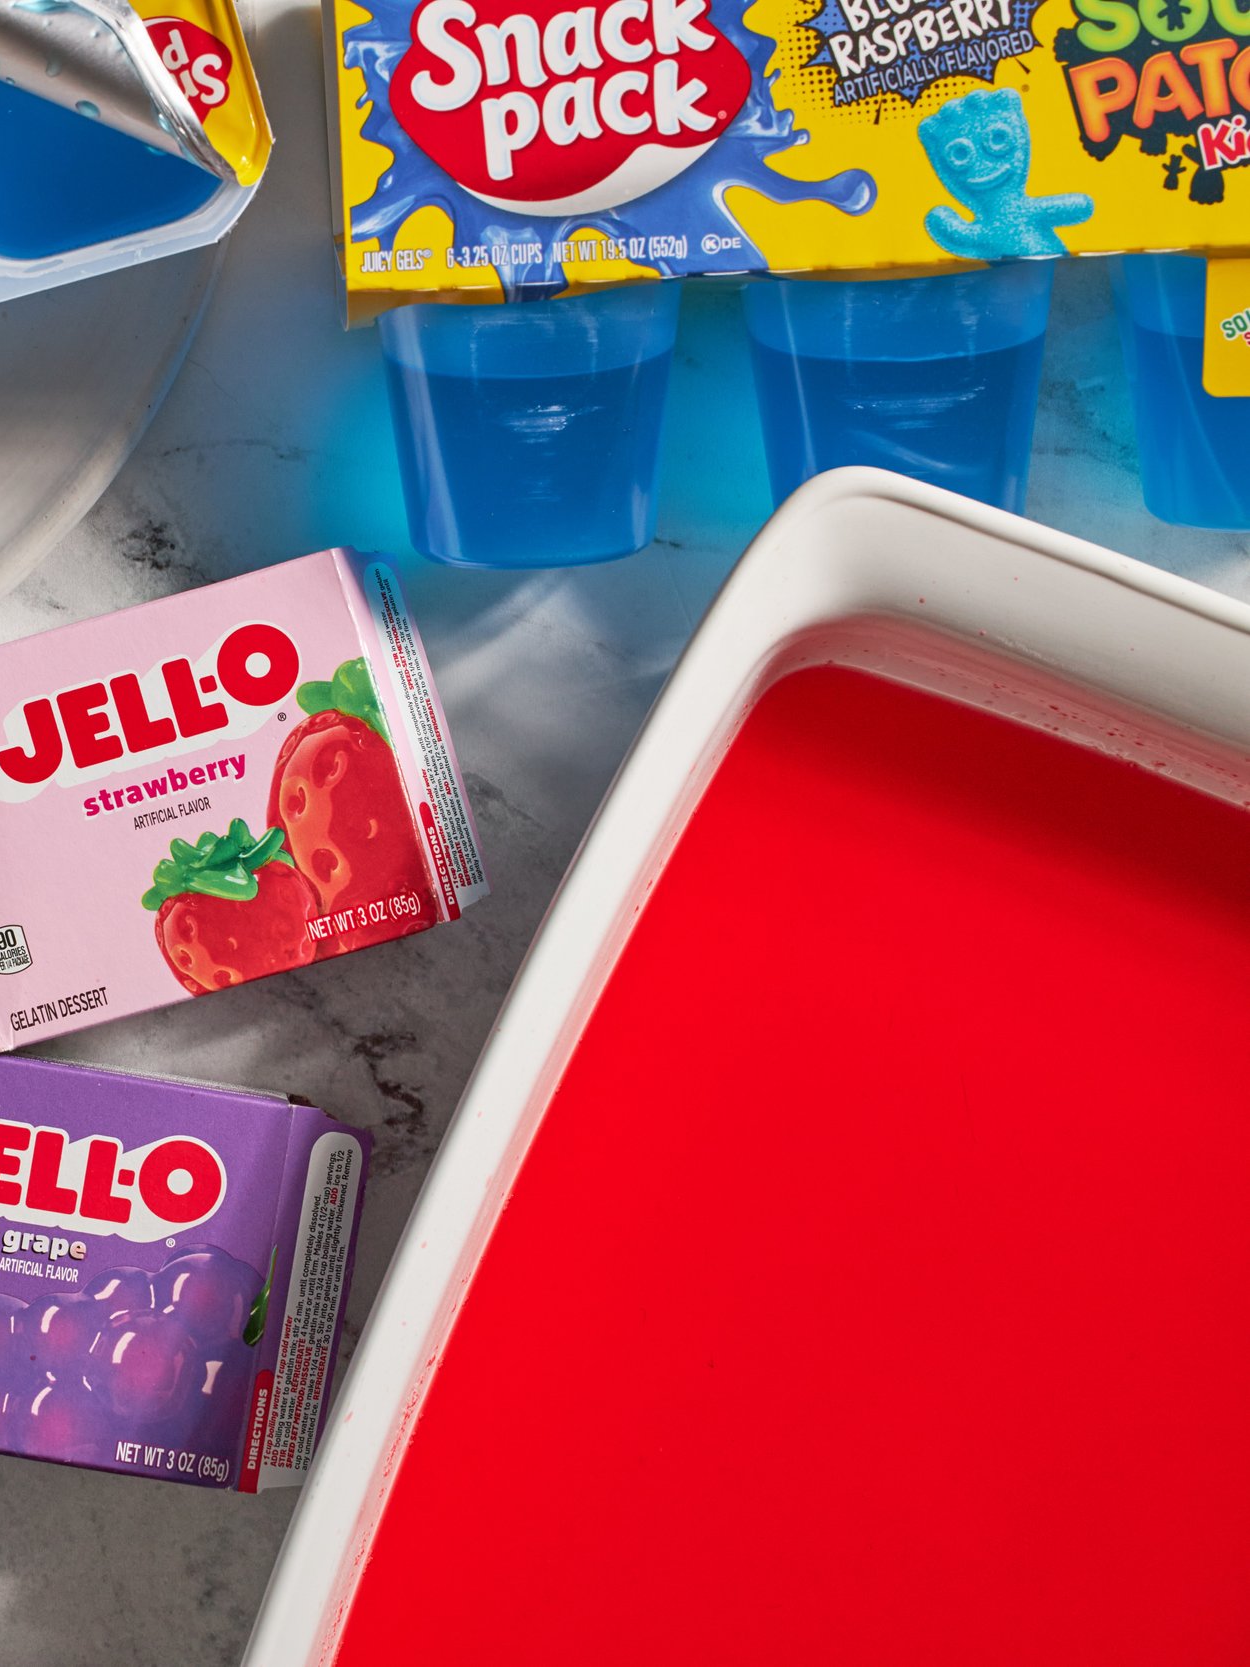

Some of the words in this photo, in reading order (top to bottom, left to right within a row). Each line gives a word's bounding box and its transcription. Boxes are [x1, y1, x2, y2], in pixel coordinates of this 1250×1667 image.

[829, 0, 1011, 77] RASPBERRY
[411, 0, 716, 111] Snack
[834, 53, 941, 105] ARTIFICIALLY
[945, 30, 1033, 73] FLAVORED
[481, 59, 717, 180] pack
[1199, 116, 1250, 169] Ki
[361, 250, 393, 272] JUICY
[491, 244, 509, 266] OZ
[511, 243, 542, 264] CUPS
[553, 241, 576, 263] NET
[577, 240, 601, 262] WT
[601, 239, 627, 260] 19.5
[628, 238, 646, 258] OZ
[649, 236, 687, 259] (552g)
[83, 754, 245, 817] strawberry
[133, 804, 178, 831] ARTIFICIAL
[179, 796, 211, 819] FLAVOR
[429, 827, 454, 904] DIRECTIONS
[308, 916, 333, 940] NET
[334, 910, 355, 932] WT
[357, 907, 367, 926] 3
[369, 901, 388, 923] OZ
[389, 892, 421, 920] (85g)
[12, 954, 30, 968] PACKAGE
[10, 1001, 58, 1031] GELATIN
[58, 987, 108, 1018] DESSERT
[327, 1152, 338, 1185] servings.
[336, 1164, 342, 1172] to
[337, 1150, 345, 1162] 1/2
[343, 1149, 353, 1180] Remove
[333, 1174, 341, 1186] ice
[330, 1188, 338, 1205] ADD
[336, 1183, 347, 1222] thickened.
[2, 1229, 87, 1260] grape
[314, 1231, 323, 1256] Makes
[322, 1233, 332, 1260] boiling
[332, 1224, 342, 1253] slightly
[310, 1258, 319, 1276] firm.
[337, 1245, 345, 1262] firm.
[45, 1265, 79, 1283] FLAVOR
[320, 1261, 328, 1276] cup
[316, 1278, 324, 1291] 3/4
[324, 1274, 332, 1302] gelatin
[333, 1284, 339, 1293] or
[307, 1297, 312, 1306] or
[302, 1308, 311, 1330] hours
[326, 1324, 332, 1333] to
[327, 1313, 334, 1322] 90
[274, 1421, 285, 1448] boiling
[283, 1387, 289, 1395] to
[286, 1358, 294, 1385] gelatin
[304, 1234, 315, 1277] completely
[309, 1318, 317, 1345] gelatin
[323, 1334, 330, 1344] 30
[292, 1339, 305, 1393] REFRIGERATE
[301, 1347, 312, 1386] DISSOLVE
[310, 1359, 318, 1377] 1-1/4
[314, 1346, 328, 1400] REFRIGERATE
[307, 1379, 315, 1400] make
[288, 1396, 296, 1420] water.
[304, 1402, 311, 1410] to
[249, 1389, 267, 1469] DIRECTIONS
[268, 1411, 278, 1438] boiling
[306, 1418, 315, 1454] unmelted
[282, 1440, 289, 1448] in
[286, 1442, 295, 1468] SPEED
[115, 1441, 141, 1463] NET
[144, 1446, 164, 1467] WT
[166, 1450, 175, 1469] 3
[178, 1452, 196, 1473] OZ
[197, 1455, 230, 1482] (85g)
